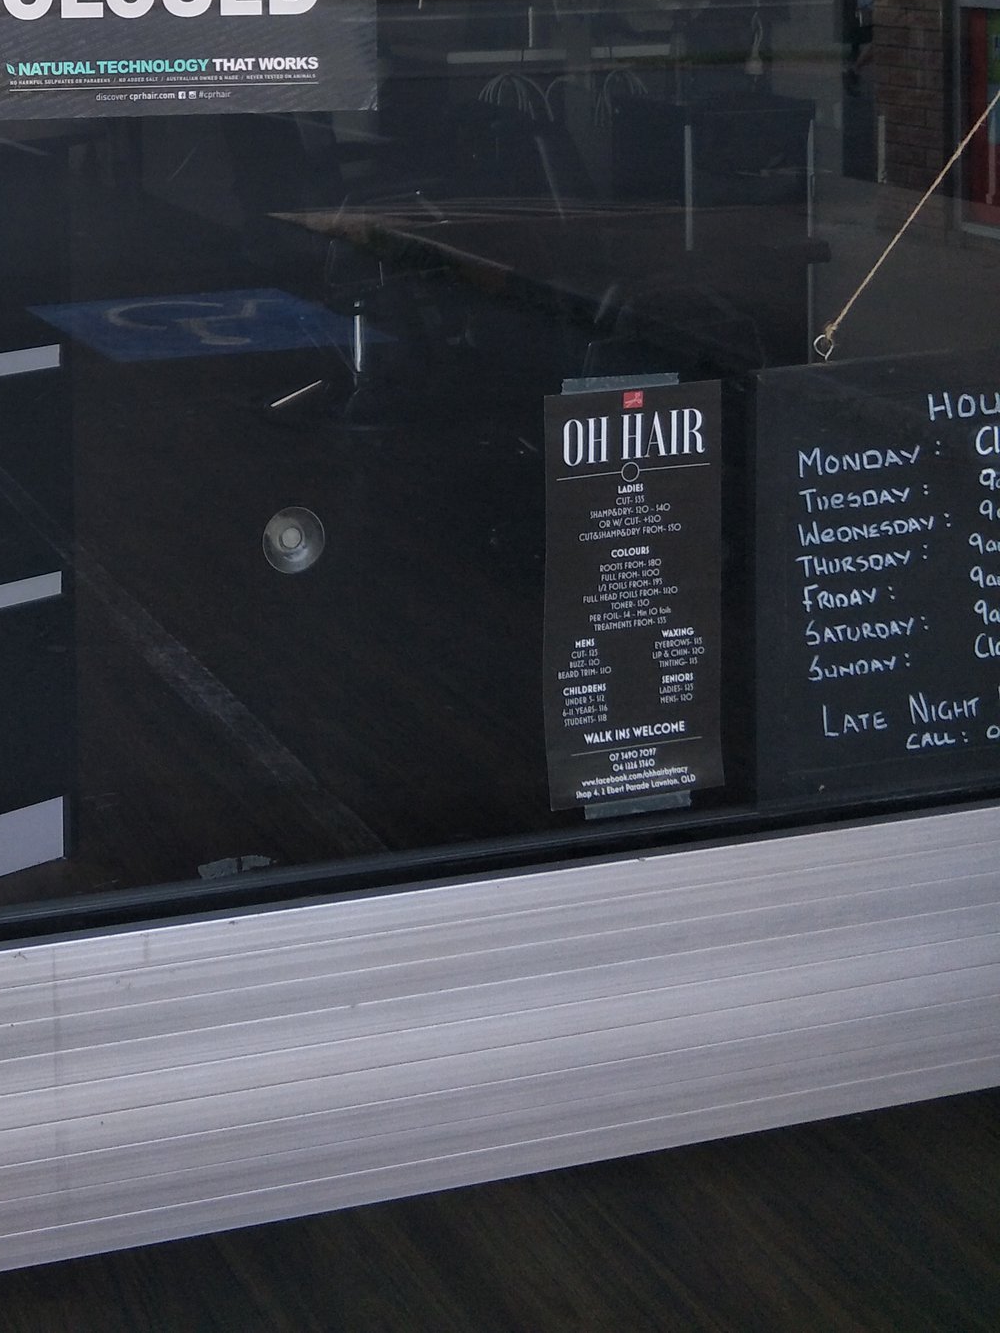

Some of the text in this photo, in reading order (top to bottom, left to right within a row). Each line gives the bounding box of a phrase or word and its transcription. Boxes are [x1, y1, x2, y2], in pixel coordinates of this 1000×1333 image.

[18, 56, 319, 76] NATURAL TECHNOLOGY THAT WORKS
[96, 92, 128, 101] discover
[129, 90, 176, 101] cprhair.com
[563, 408, 705, 467] OH HAIR
[798, 445, 920, 478] MONDAY
[617, 483, 644, 494] LADIES
[611, 546, 650, 558] COLOURS
[599, 563, 623, 572] ROOTS
[795, 550, 910, 578] THURSDAY
[601, 573, 617, 582] FULL
[609, 581, 628, 591] FOILS
[583, 595, 598, 603] FULL
[599, 593, 618, 601] HEAD
[619, 590, 638, 599] FOILS
[802, 586, 878, 613] FRIDAY
[661, 627, 695, 638] WAXING
[805, 616, 914, 647] SATURDAY
[575, 638, 595, 649] MENS
[808, 655, 897, 682] SUNDAY
[661, 672, 694, 684] SENIORS
[563, 683, 607, 696] CHILDRENS
[822, 692, 980, 738] LATE NIGHT
[584, 720, 686, 745] WALK INS WELCOME
[625, 781, 650, 792] Parade
